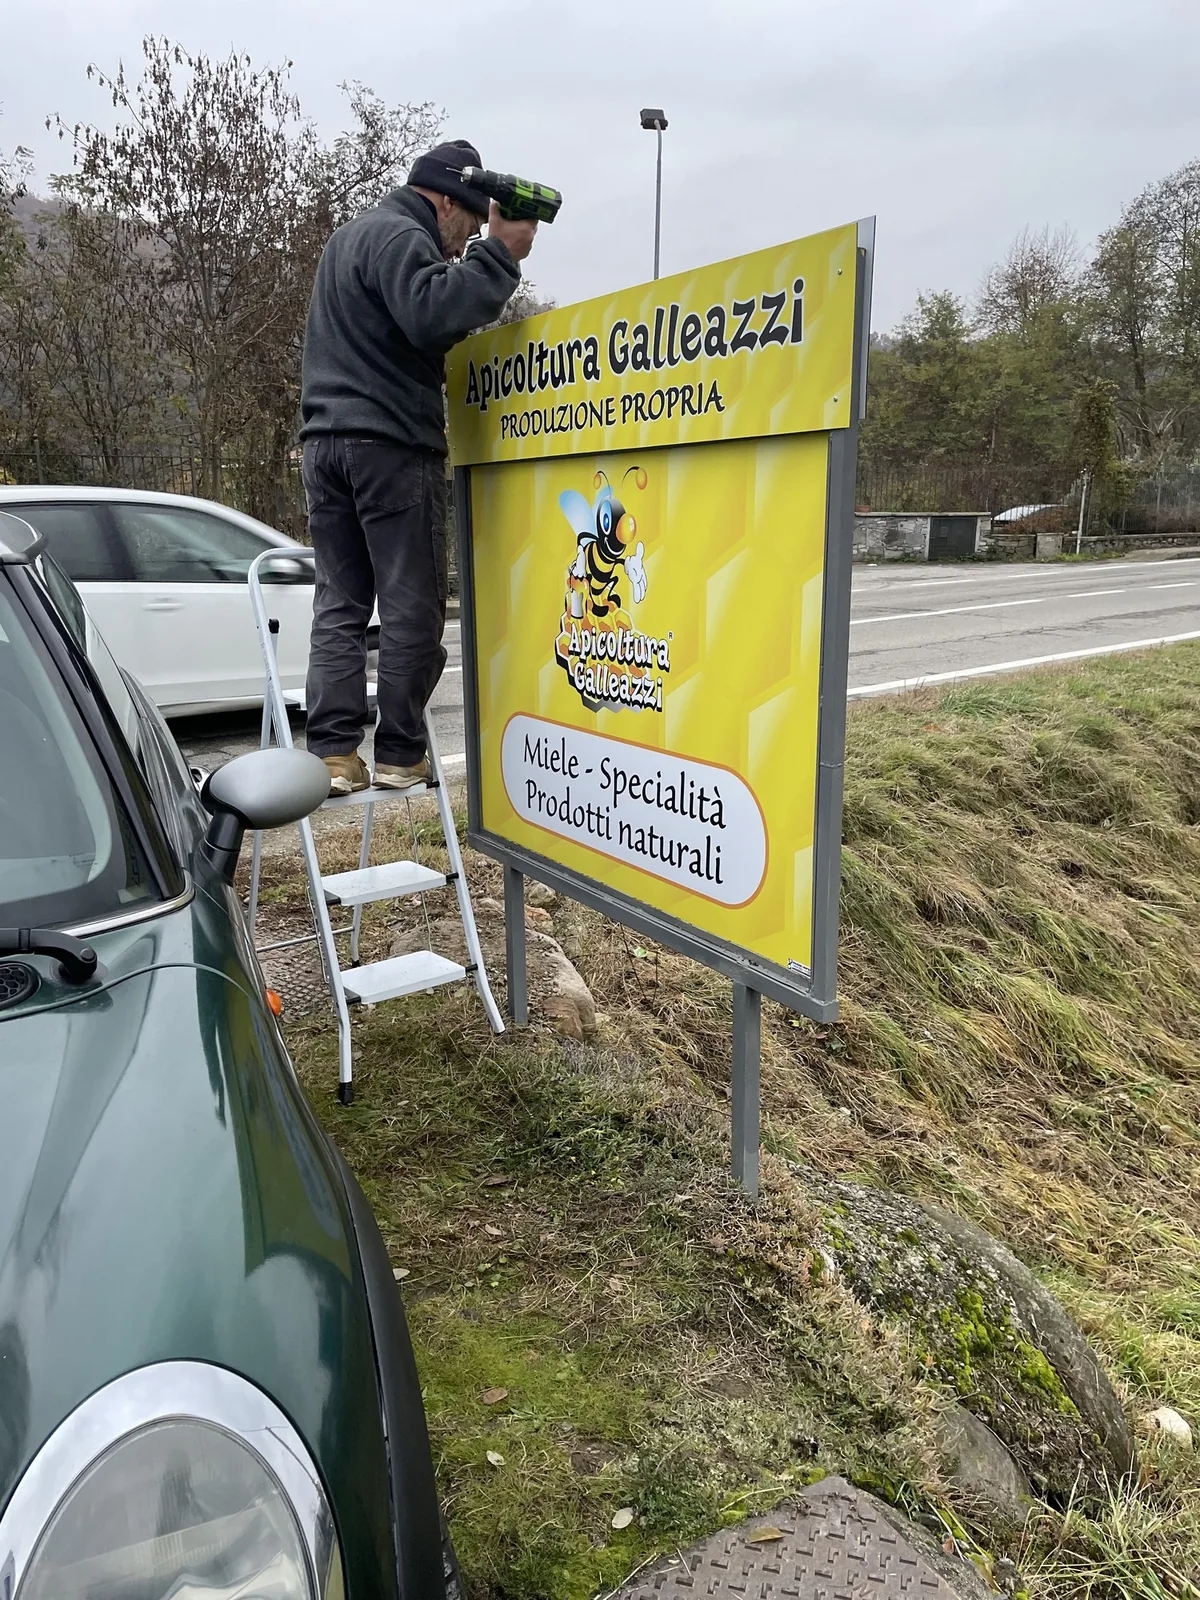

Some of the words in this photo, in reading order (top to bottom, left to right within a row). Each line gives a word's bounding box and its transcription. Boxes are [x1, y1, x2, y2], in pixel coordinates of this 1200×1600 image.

[465, 335, 600, 412] Apicoltura
[608, 277, 805, 375] Galleazzi
[500, 396, 617, 440] PRODUZIONE
[620, 380, 725, 424] PROPRIA
[568, 623, 670, 672] Apicoltura
[574, 662, 663, 712] Galleazzi
[523, 733, 579, 779] Miele
[600, 757, 726, 829] Specialità
[525, 779, 612, 840] Prodotti
[619, 820, 723, 885] naturali
